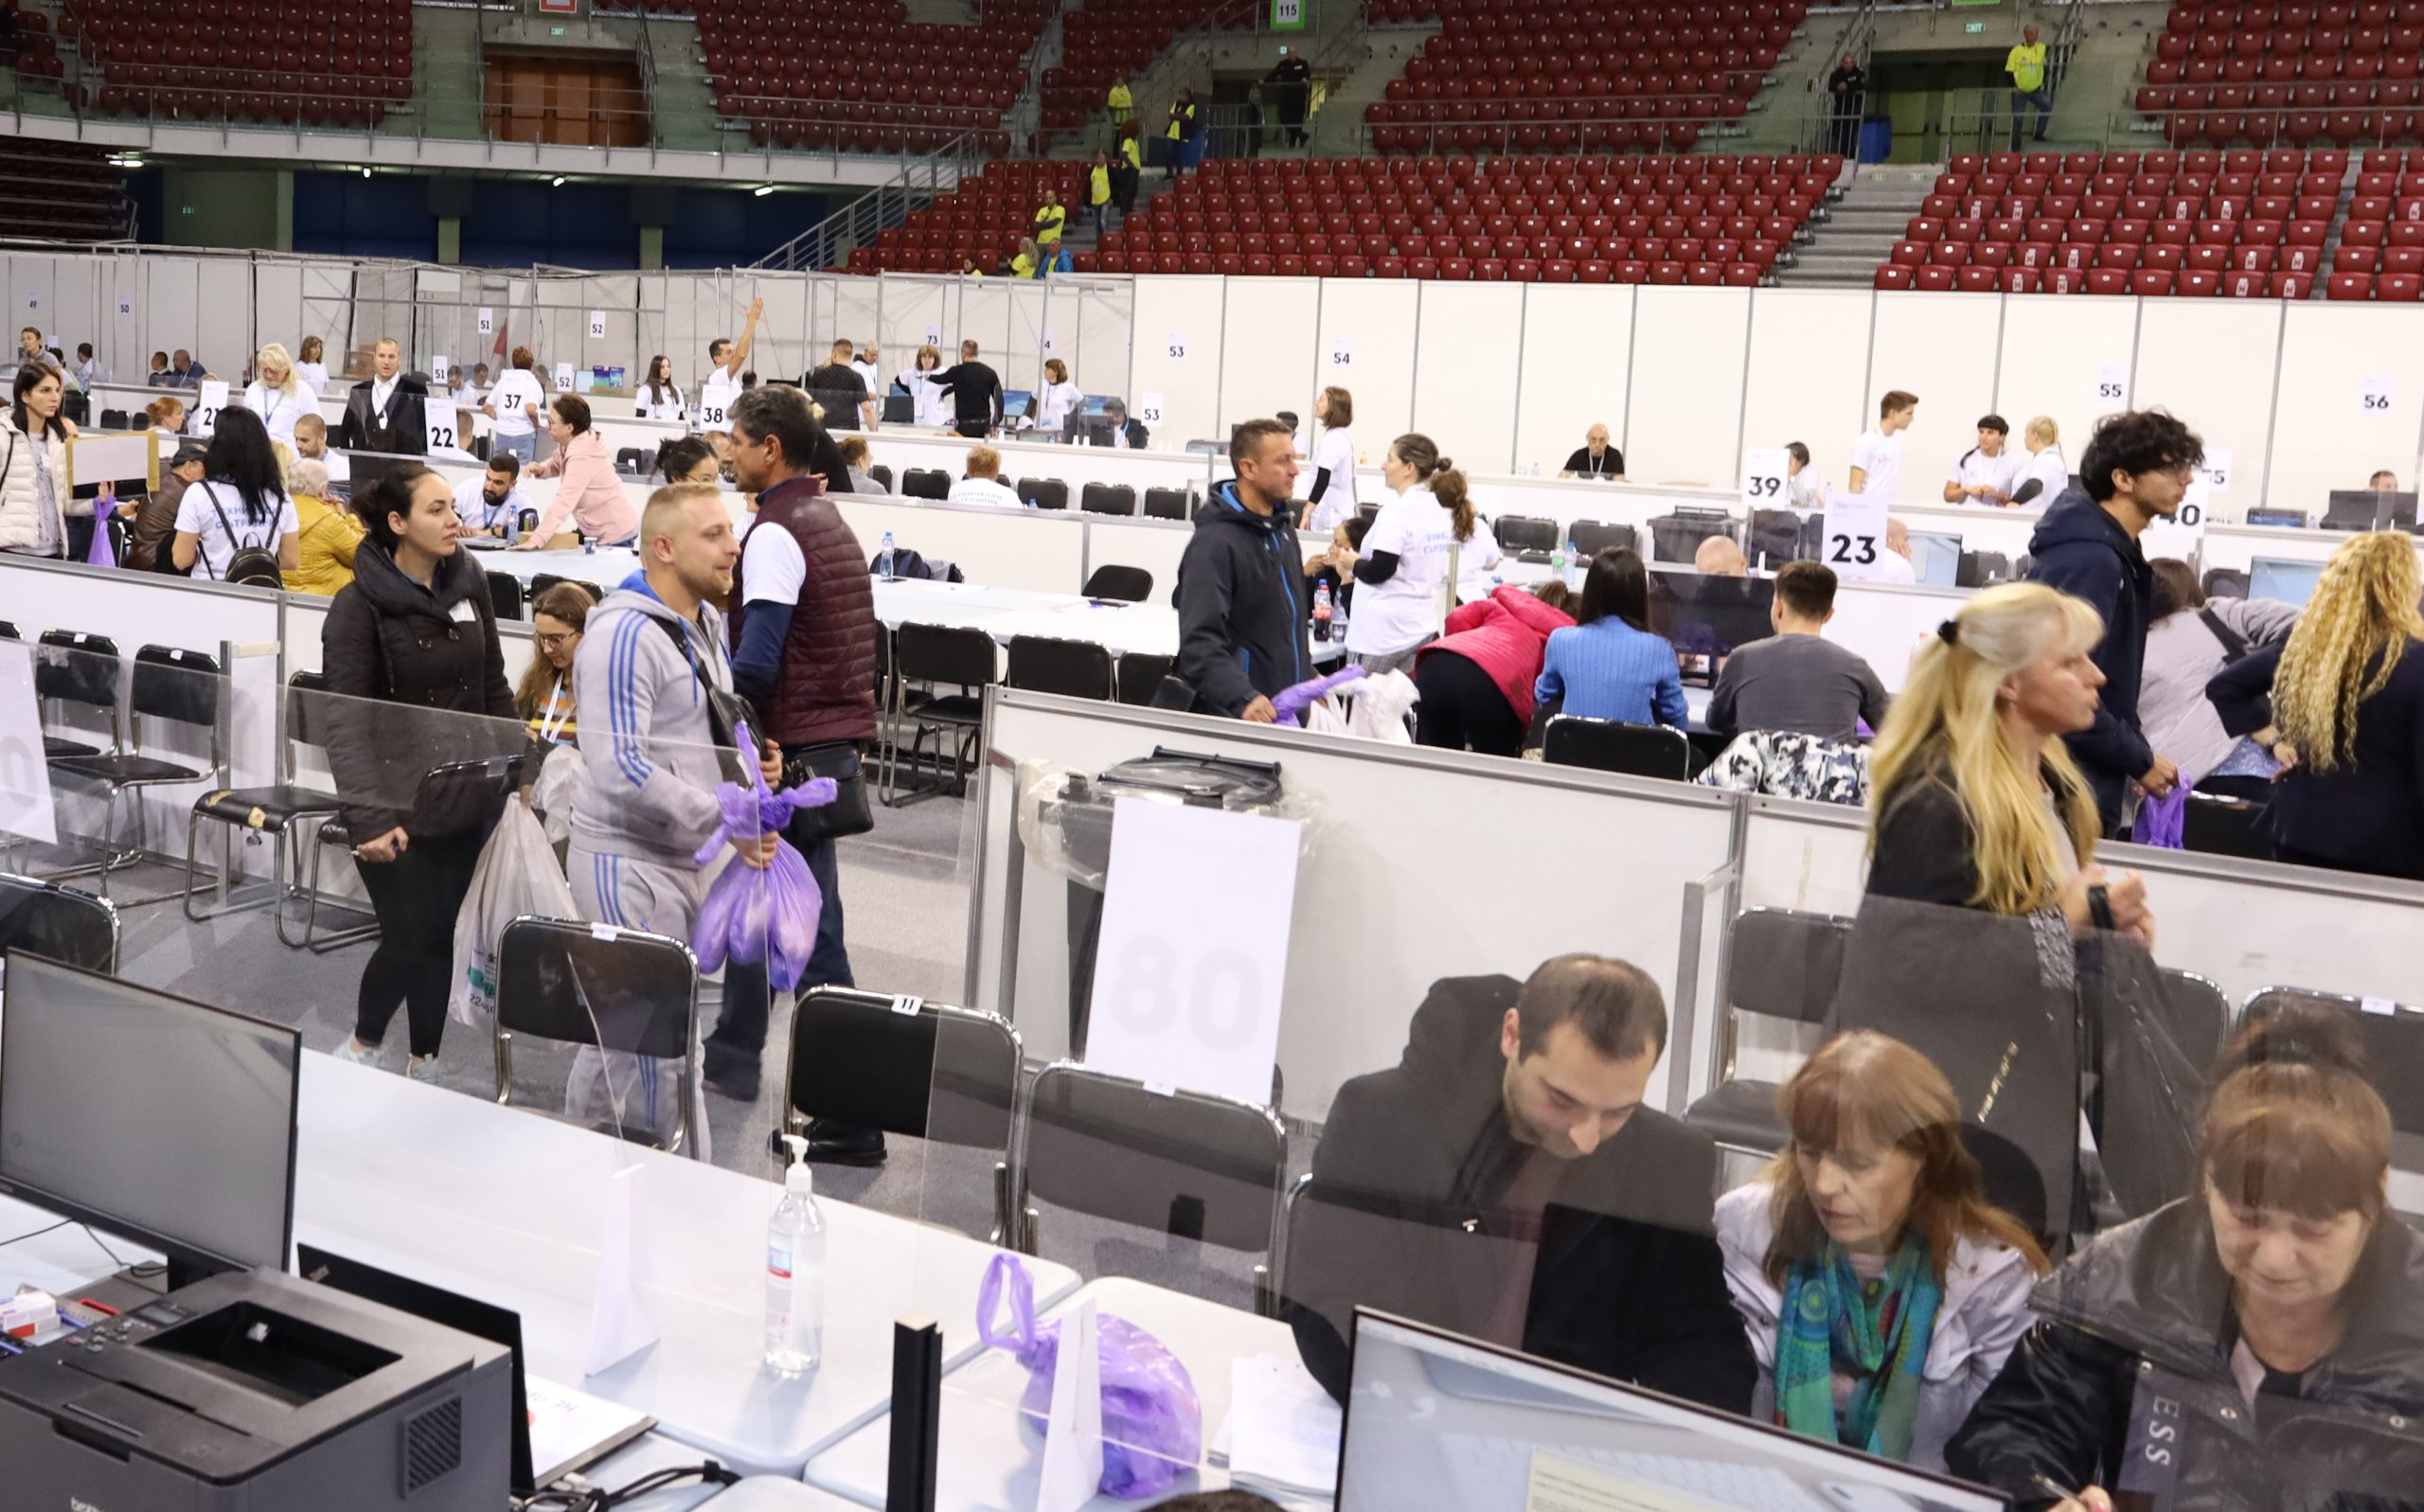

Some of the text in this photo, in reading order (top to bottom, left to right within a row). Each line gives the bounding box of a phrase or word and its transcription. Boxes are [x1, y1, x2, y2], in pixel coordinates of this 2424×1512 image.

[1279, 4, 1297, 17] 115
[121, 304, 130, 313] 50
[480, 320, 490, 329] 51
[592, 324, 603, 333] 52
[927, 335, 937, 345] 73
[1169, 346, 1185, 358] 53
[1333, 352, 1350, 365] 54
[436, 369, 445, 379] 51
[559, 377, 570, 387] 52
[2099, 383, 2122, 398] 55
[505, 394, 522, 409] 37
[2363, 395, 2389, 409] 56
[704, 407, 723, 423] 38
[1144, 408, 1160, 421] 53
[431, 426, 454, 448] 22
[1748, 476, 1781, 497] 39
[1830, 534, 1877, 565] 23
[901, 997, 915, 1010] 11
